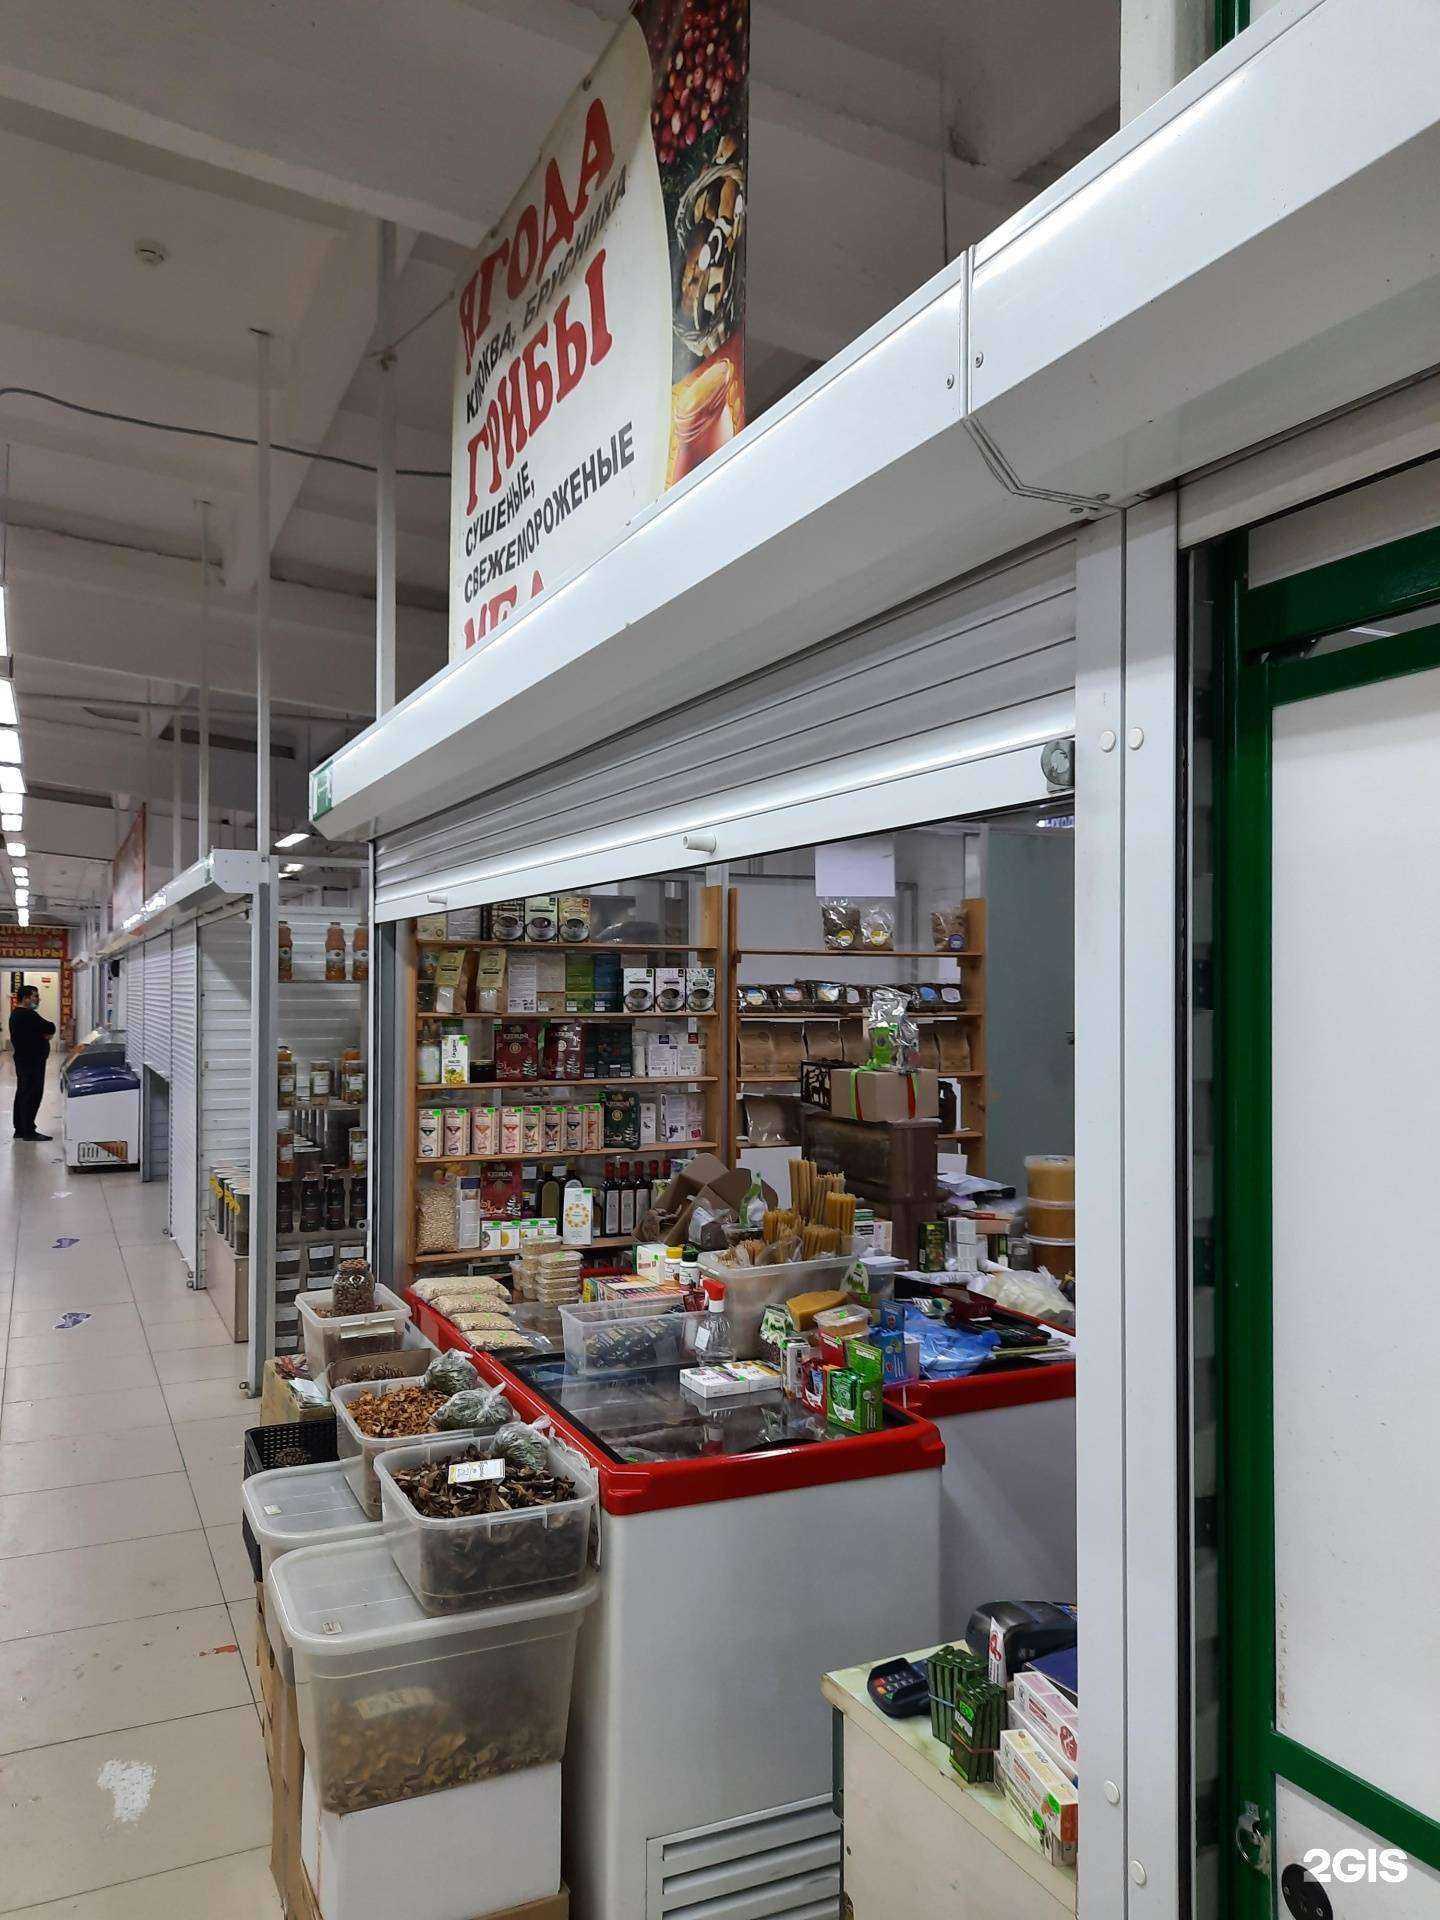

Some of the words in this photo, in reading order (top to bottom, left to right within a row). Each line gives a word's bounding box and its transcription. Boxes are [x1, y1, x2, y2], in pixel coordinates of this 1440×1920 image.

[460, 98, 615, 376] ЯГОДА
[523, 164, 627, 333] БРУСНИКА
[466, 248, 613, 516] ГРИБЫ
[464, 421, 635, 604] СВЕЖЕМОРОЖЕНЫЕ
[465, 460, 536, 558] СУШЕНЫЕ,
